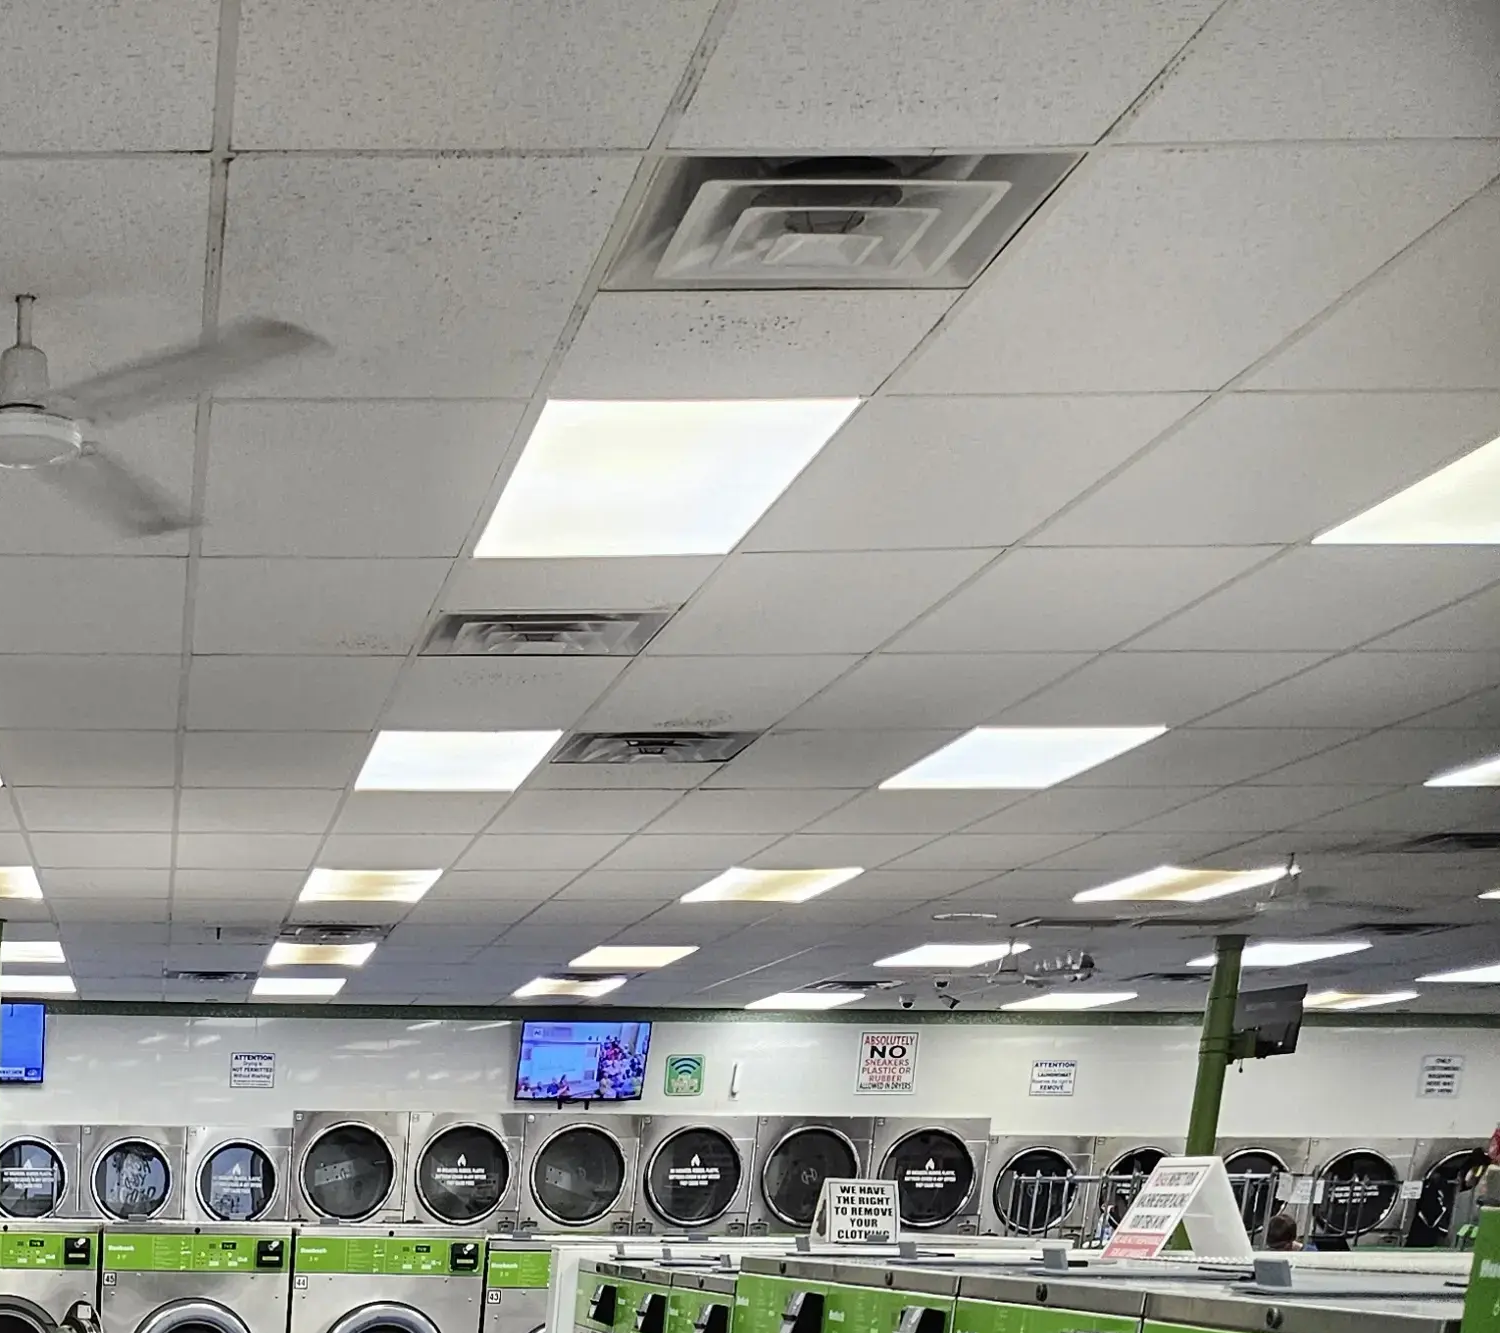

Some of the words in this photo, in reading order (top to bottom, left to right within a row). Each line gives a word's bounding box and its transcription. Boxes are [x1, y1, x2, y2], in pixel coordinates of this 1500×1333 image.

[864, 1036, 915, 1045] ABSOLUTELY
[870, 1045, 907, 1059] NO
[865, 1059, 909, 1067] SNEAKERS
[862, 1067, 897, 1075] PLASTIC
[899, 1067, 911, 1075] OR
[860, 1082, 884, 1090] ALLOWED
[840, 1186, 856, 1194] WE
[859, 1186, 885, 1195] HAVE
[836, 1196, 856, 1205] THE
[859, 1197, 890, 1206] RIGHT
[835, 1207, 847, 1216] TO
[851, 1207, 893, 1216] REMOVE
[850, 1218, 878, 1228] YOUR
[105, 1276, 115, 1284] 45
[489, 1293, 499, 1302] 43
